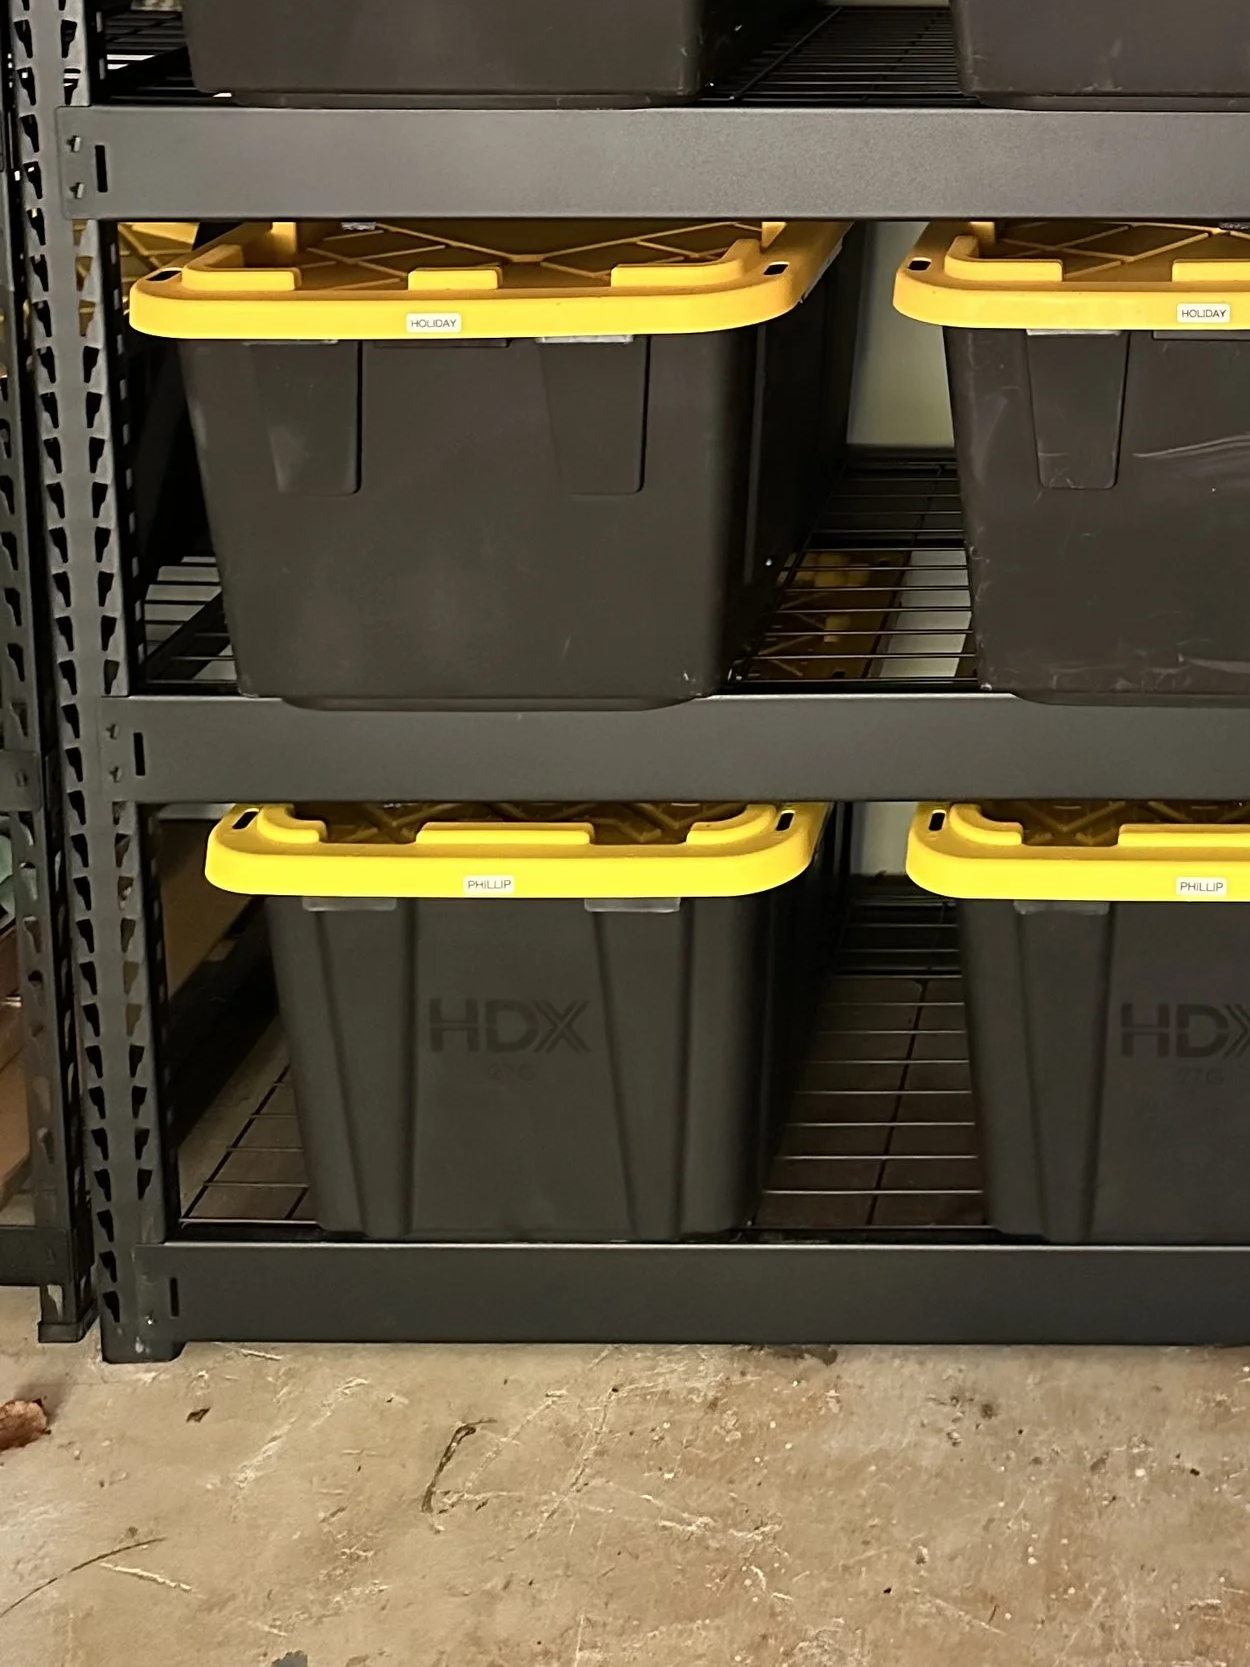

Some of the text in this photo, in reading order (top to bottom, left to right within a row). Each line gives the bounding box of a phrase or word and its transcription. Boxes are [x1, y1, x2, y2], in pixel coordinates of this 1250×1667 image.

[1181, 309, 1227, 318] HOLIDAY
[410, 319, 457, 328] HOLIDAY
[467, 879, 512, 889] PHILLIP
[1179, 881, 1224, 892] PHILLIP
[429, 998, 592, 1053] HDX
[486, 1063, 537, 1081] 27G
[1176, 1067, 1226, 1086] 27G
